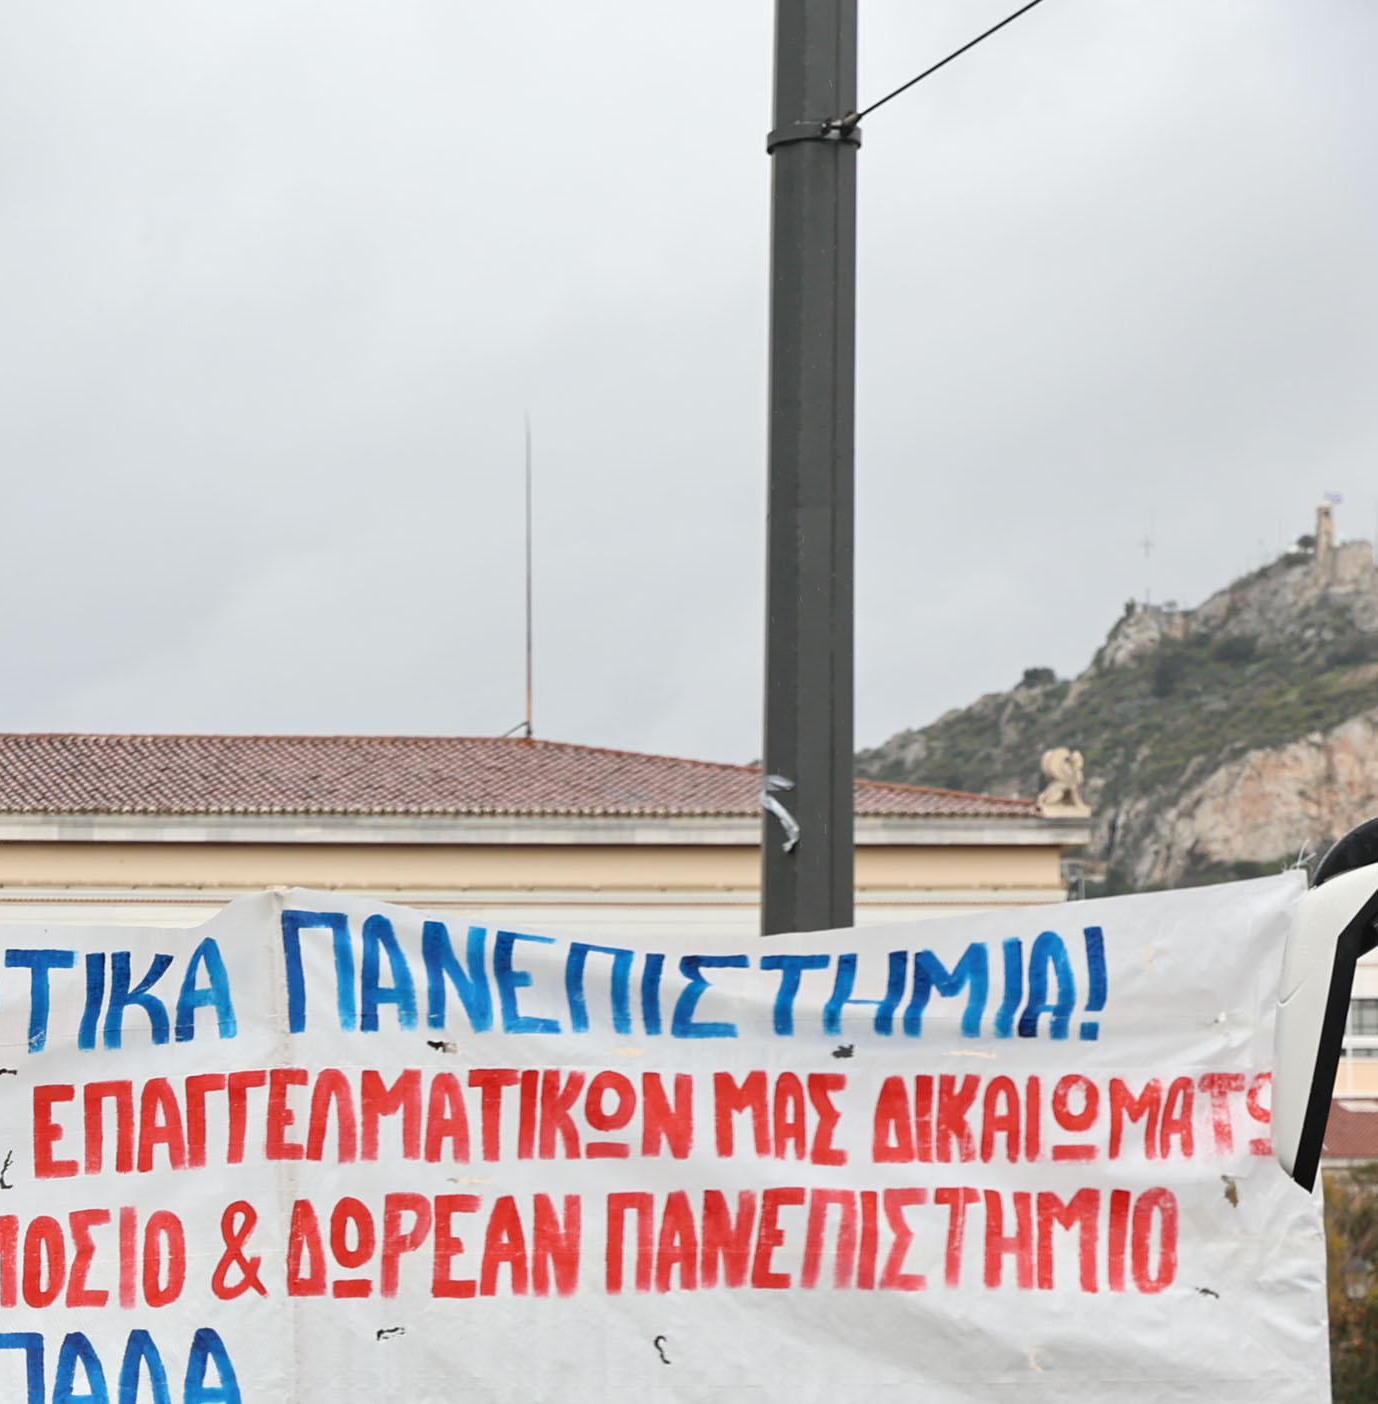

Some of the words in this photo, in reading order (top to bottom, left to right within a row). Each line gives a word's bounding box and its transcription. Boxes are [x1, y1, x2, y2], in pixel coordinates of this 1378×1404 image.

[283, 911, 1109, 1041] ΠΑΝΕΠΙΣΤΗΜΙΑ!
[35, 1069, 695, 1181] ΕΠΑΓΓΕΛΜΑΤΙΚΩΝ
[714, 1071, 849, 1167] ΜΑΣ
[213, 1201, 269, 1301] &
[287, 1193, 582, 1300] ΔΩΡΕΑΝ
[607, 1188, 1179, 1295] ΠΑΝΕΠΙΣΤΗΜΙΟ
